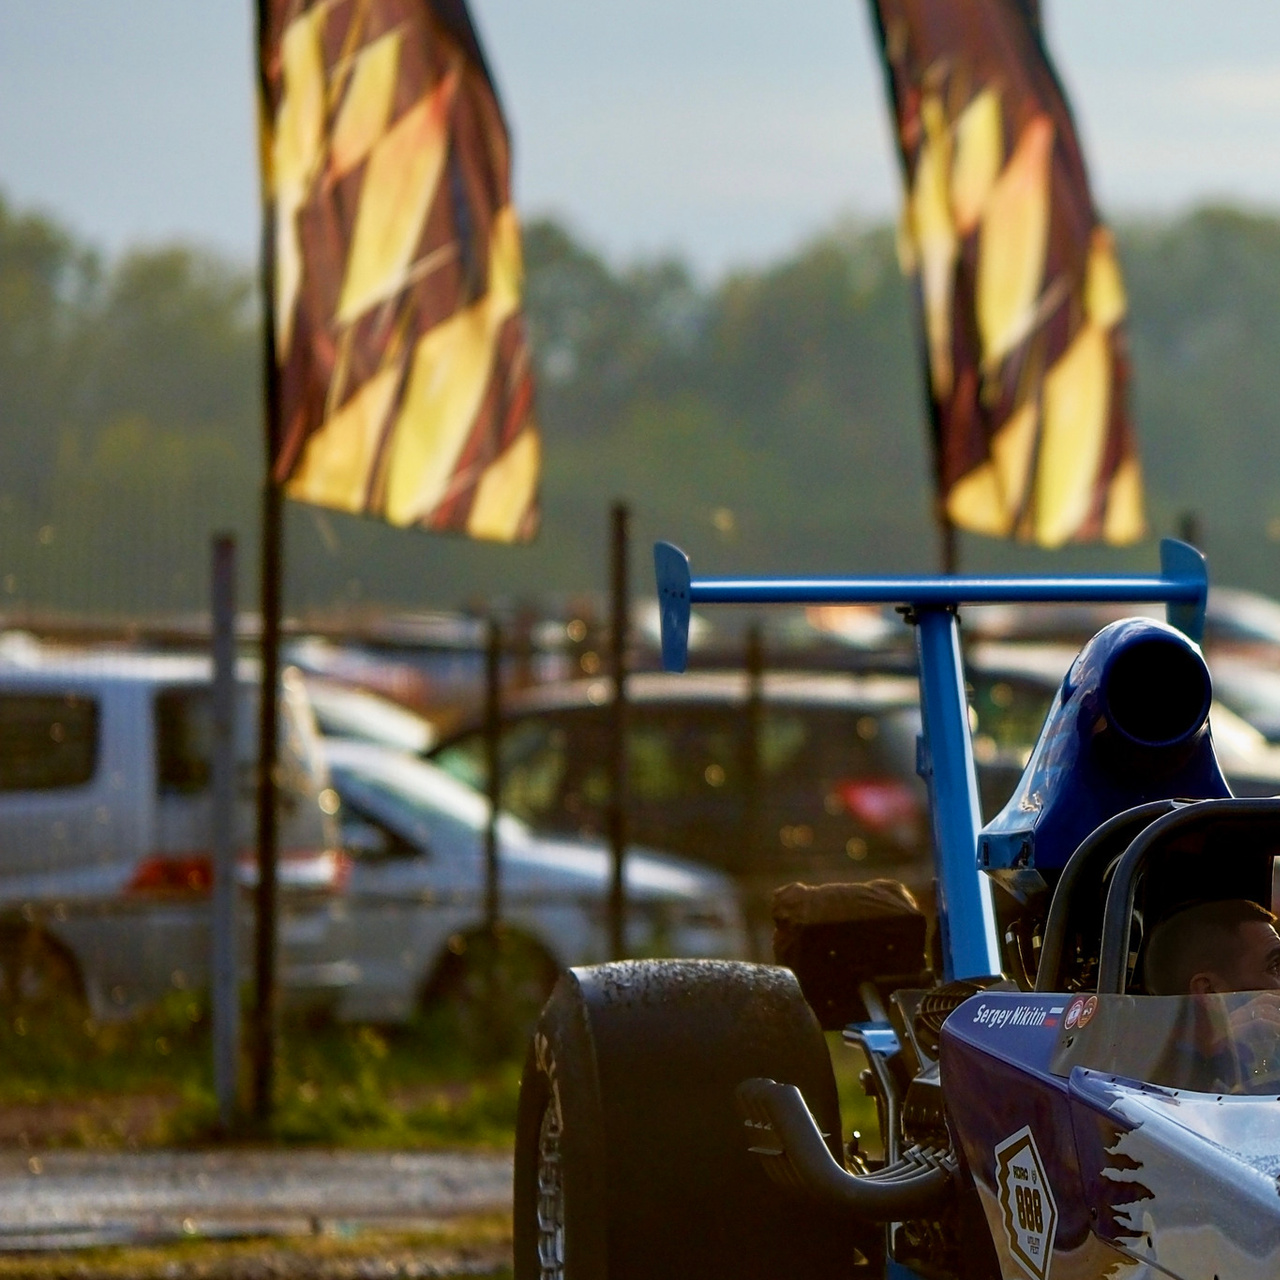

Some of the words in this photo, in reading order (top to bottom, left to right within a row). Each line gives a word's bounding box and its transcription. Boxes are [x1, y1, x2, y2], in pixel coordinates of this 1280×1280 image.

[973, 1004, 1012, 1028] Sergey
[1009, 1006, 1046, 1026] Nikitin
[1015, 1185, 1043, 1233] 888
